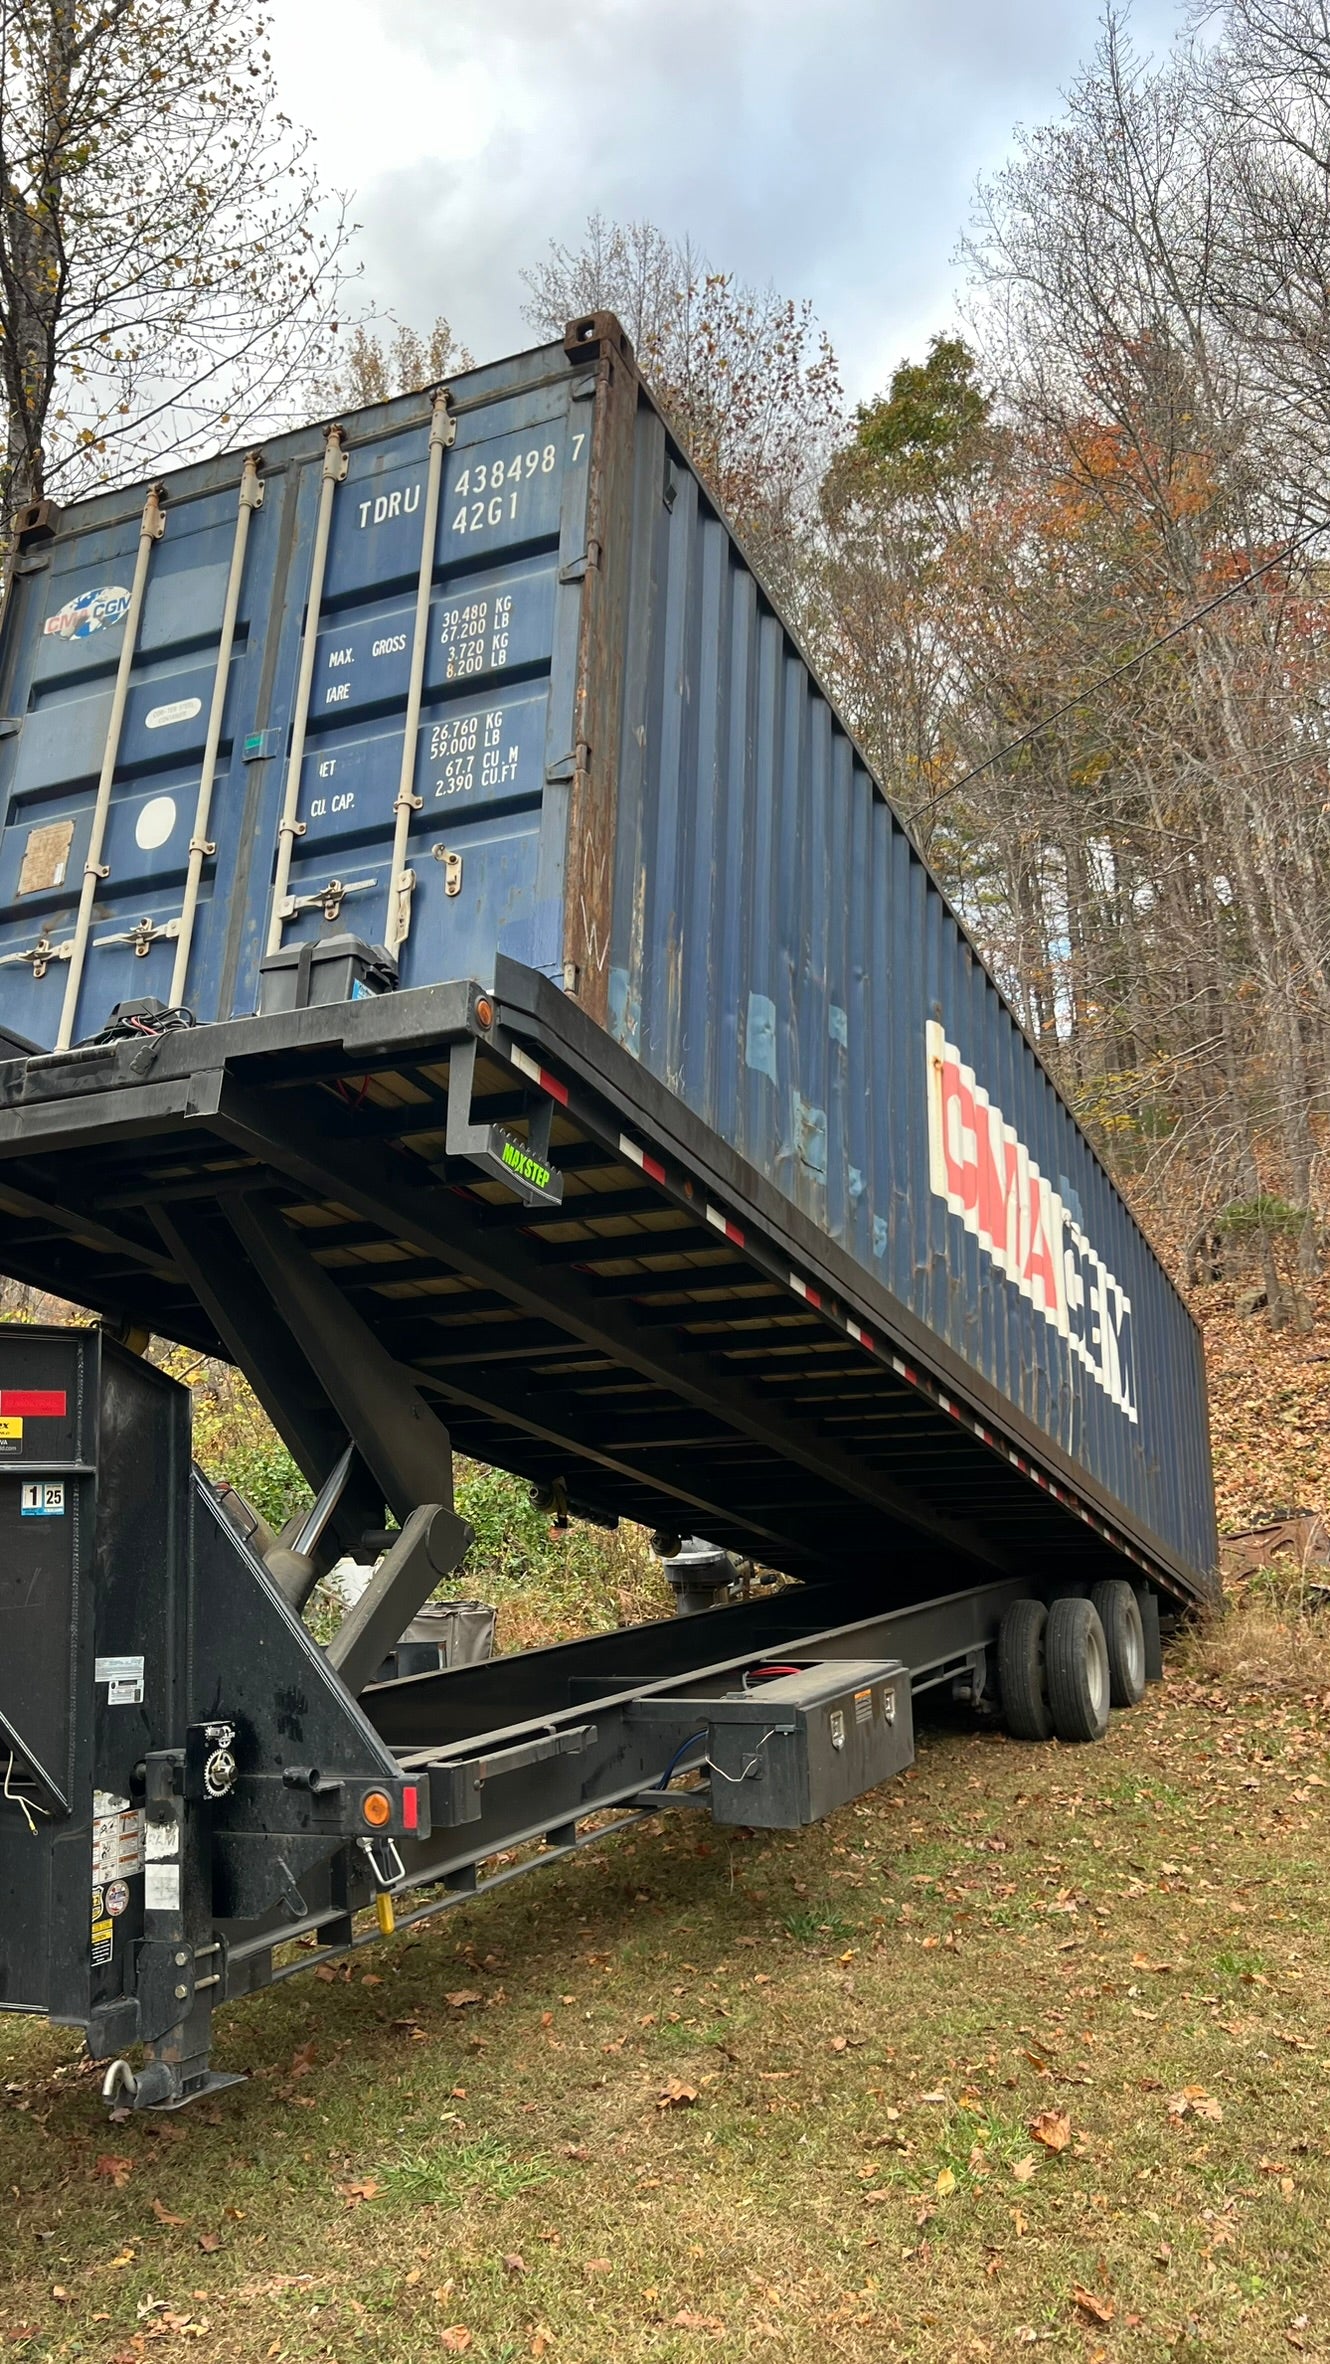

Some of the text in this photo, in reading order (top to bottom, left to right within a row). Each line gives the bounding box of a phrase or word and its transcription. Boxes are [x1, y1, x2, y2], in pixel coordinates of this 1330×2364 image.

[359, 433, 585, 528] TDRU 438498 7
[452, 492, 518, 534] 42G1
[442, 596, 512, 628] 30.480 KG
[440, 614, 510, 644] 67.200 LB
[328, 634, 407, 668] MAX. GROSS
[447, 632, 509, 662] 3.720 KG
[446, 650, 507, 679] 8.200 LB
[431, 712, 503, 743] 26.760 KG
[429, 729, 500, 760] 59.000 LB
[435, 763, 518, 797] 2.390 CU.FT
[445, 756, 475, 777] 67.7
[331, 793, 355, 812] CAP.
[942, 1061, 1057, 1311] CMA
[30, 1486, 62, 1506] 1 25
